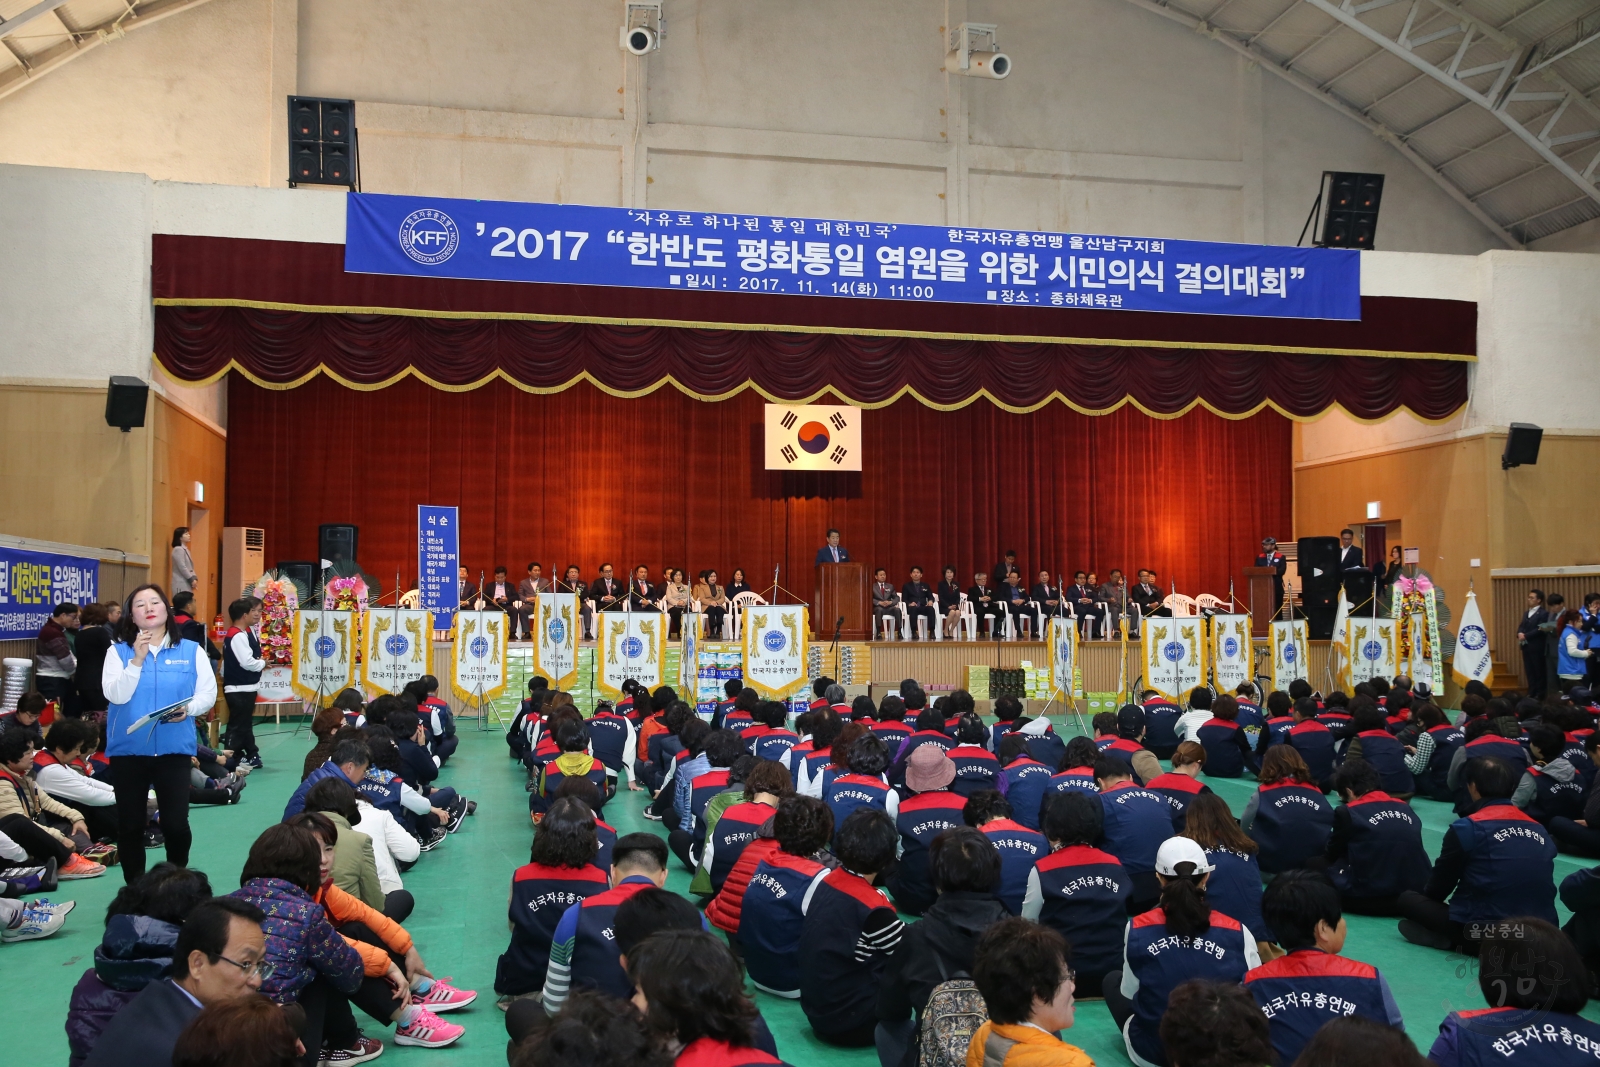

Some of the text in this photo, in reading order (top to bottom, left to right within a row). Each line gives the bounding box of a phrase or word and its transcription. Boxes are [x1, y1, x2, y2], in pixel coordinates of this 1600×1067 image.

[407, 211, 452, 227] 한국자유총연맹
[703, 215, 760, 232] 하나된
[768, 218, 806, 235] 통일
[411, 230, 447, 246] KFF
[947, 229, 1165, 254] 한국자유총연맹 울산남구지회
[409, 247, 436, 263] FREEDOM
[435, 231, 456, 262] FEDERATION
[737, 239, 864, 277] 평화통일
[876, 246, 969, 282] 염원을
[979, 252, 1039, 285] 위한
[1048, 256, 1164, 292] 시민의식
[831, 281, 878, 297] 14(화)
[890, 285, 934, 298] 11:00
[1050, 291, 1122, 307] 종하체육관
[12, 562, 51, 604] 대한민국
[752, 667, 798, 675] 한국자유총연맹
[834, 790, 873, 803] 한국자유총연맹
[1116, 791, 1160, 804] 한국자유총연맹
[1275, 795, 1320, 811] 한국자유총연맹
[913, 820, 956, 835] 한국자유총
[1493, 826, 1545, 845] 한국자유총연맹
[1061, 874, 1120, 897] 한국자유총연맹
[1261, 990, 1356, 1020] 한국자유총연맹
